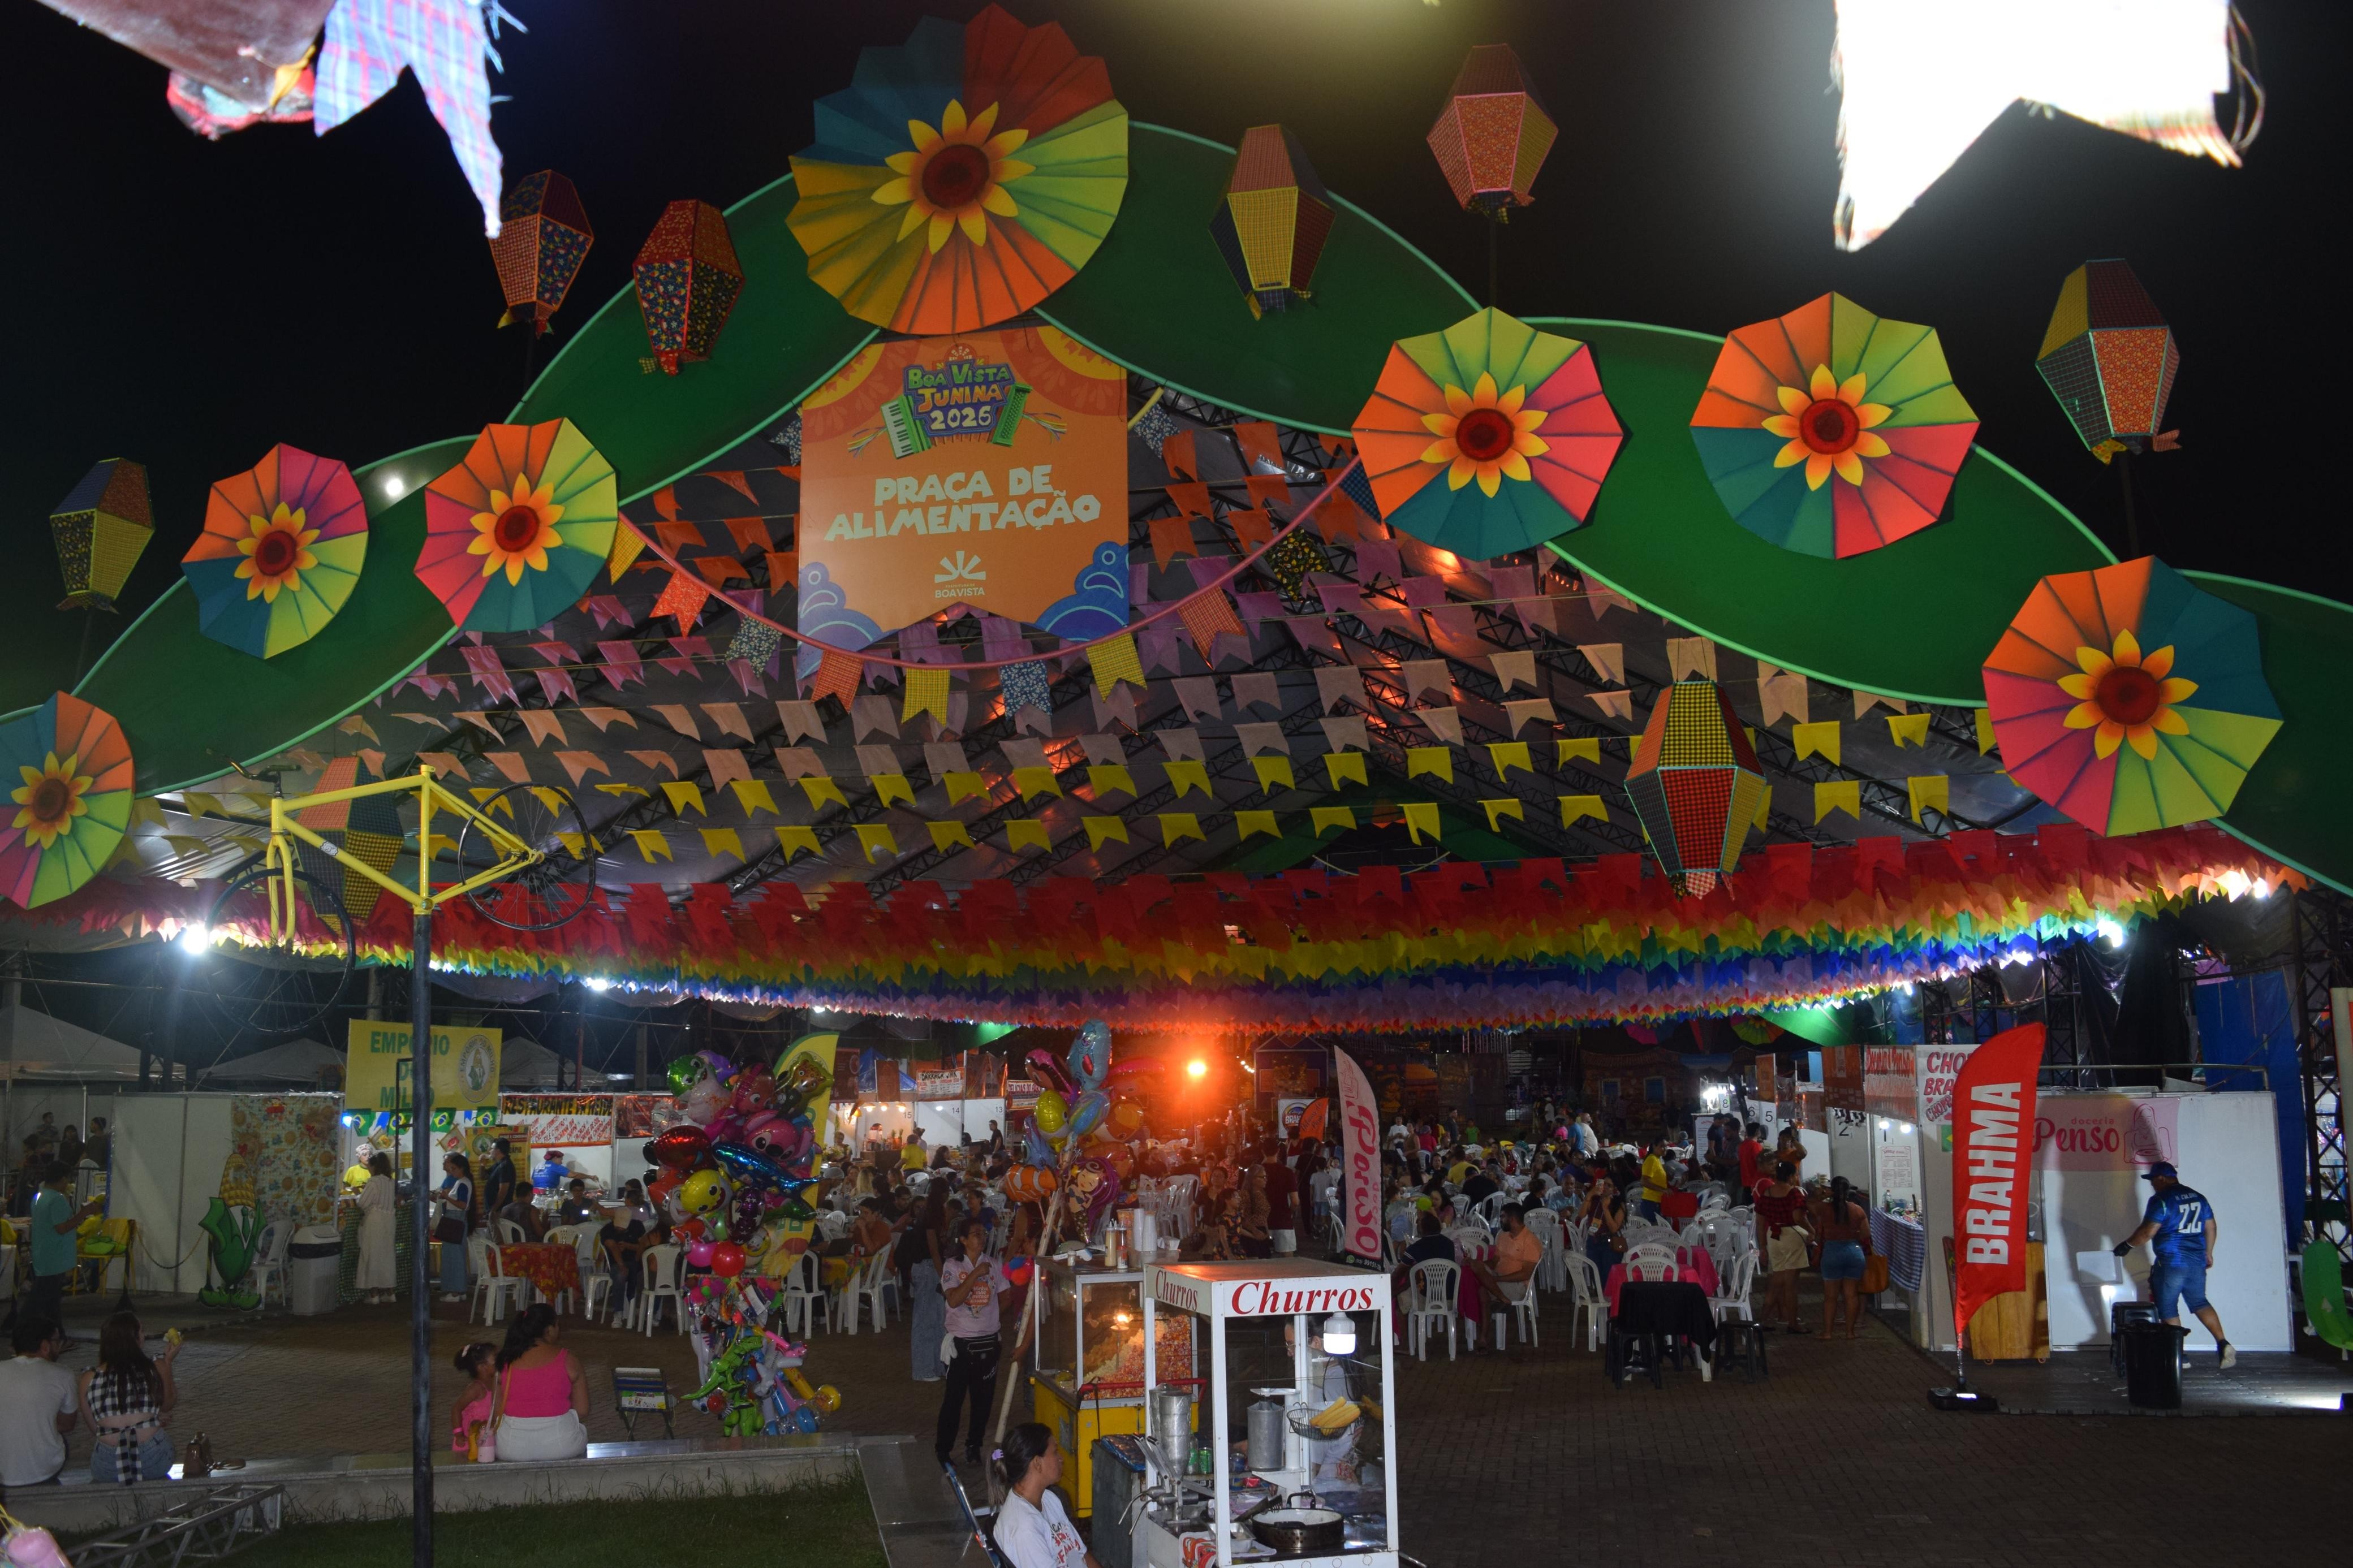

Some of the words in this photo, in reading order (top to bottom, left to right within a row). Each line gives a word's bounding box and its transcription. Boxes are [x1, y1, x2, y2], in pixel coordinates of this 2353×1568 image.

[908, 368, 947, 388] BOA
[951, 364, 1010, 383] VISTA
[917, 384, 1003, 412] JUNINA
[930, 405, 992, 430] 2026
[874, 470, 993, 507] PRAÇA
[1009, 464, 1054, 496] DE
[824, 490, 1101, 542] ALIMENTAÇÃO
[935, 589, 956, 598] BOA
[956, 587, 985, 597] VISTA
[1927, 1051, 1972, 1074] CHO
[1722, 1099, 1729, 1108] 8
[1748, 1107, 1755, 1117] 6
[1765, 1111, 1773, 1122] 5
[2071, 1117, 2114, 1125] doceria
[1838, 1121, 1849, 1137] 2
[2032, 1117, 2120, 1153] Penso
[1967, 1082, 2022, 1265] BRAHMA
[1156, 1269, 1198, 1312] Churros
[1231, 1281, 1373, 1315] Churros
